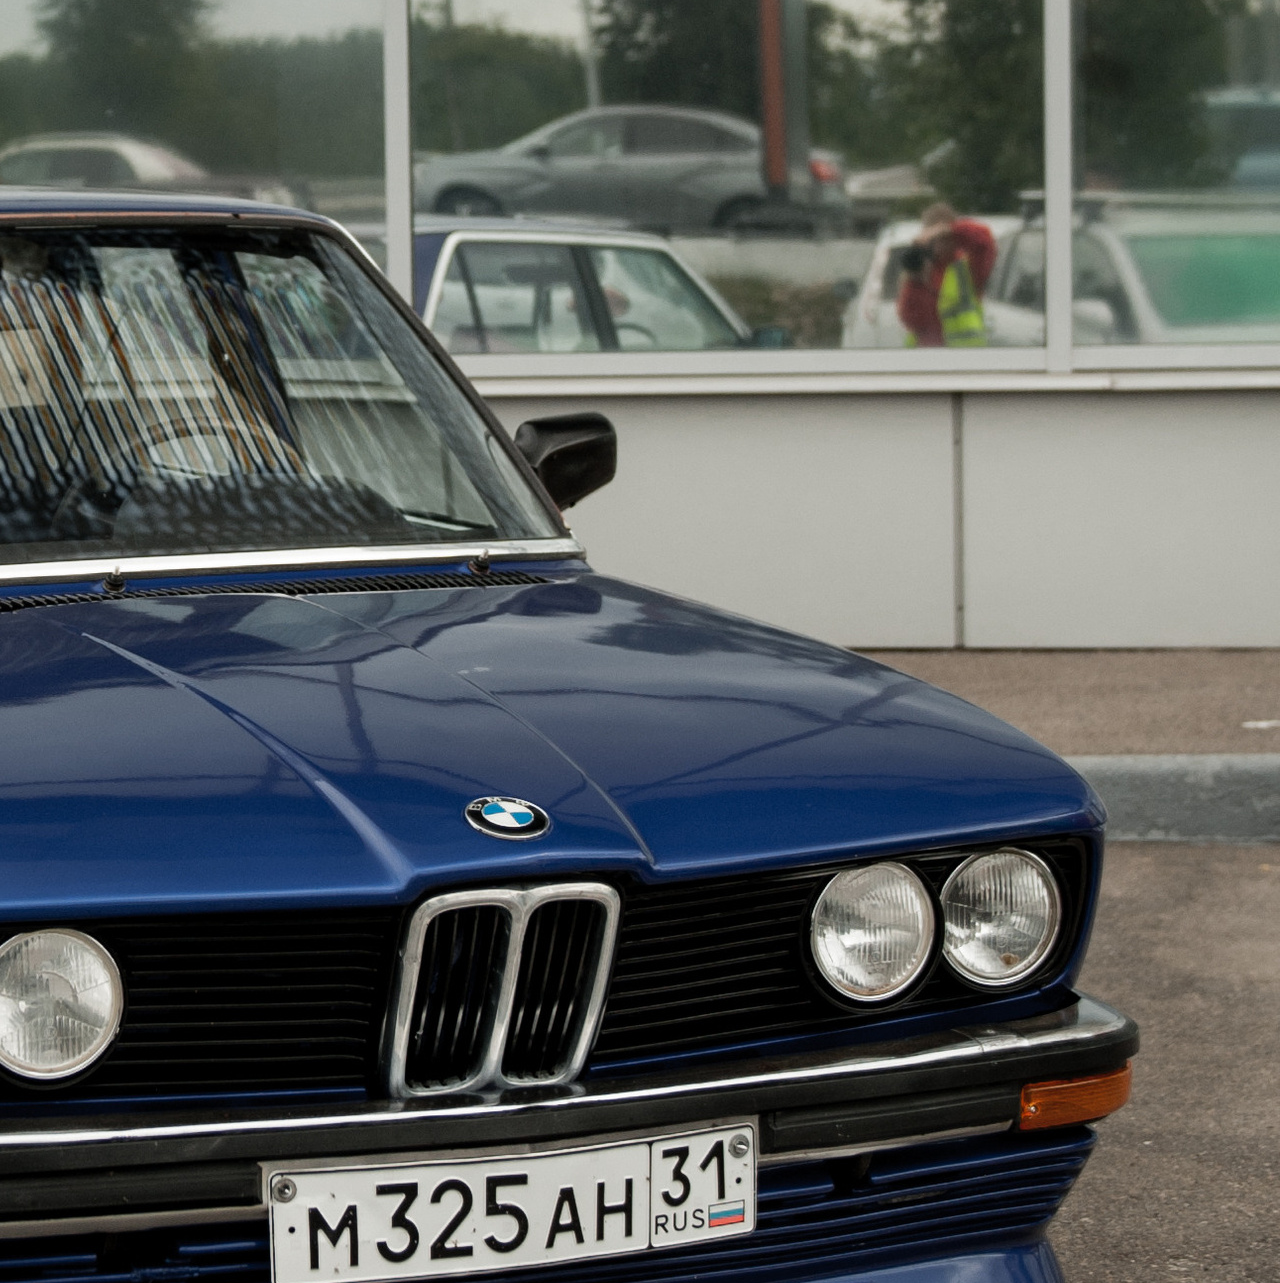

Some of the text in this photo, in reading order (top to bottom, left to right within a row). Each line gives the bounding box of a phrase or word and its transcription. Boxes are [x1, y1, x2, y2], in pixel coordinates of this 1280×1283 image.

[308, 1139, 726, 1270] M325AH 31
[654, 1208, 705, 1235] RUS
